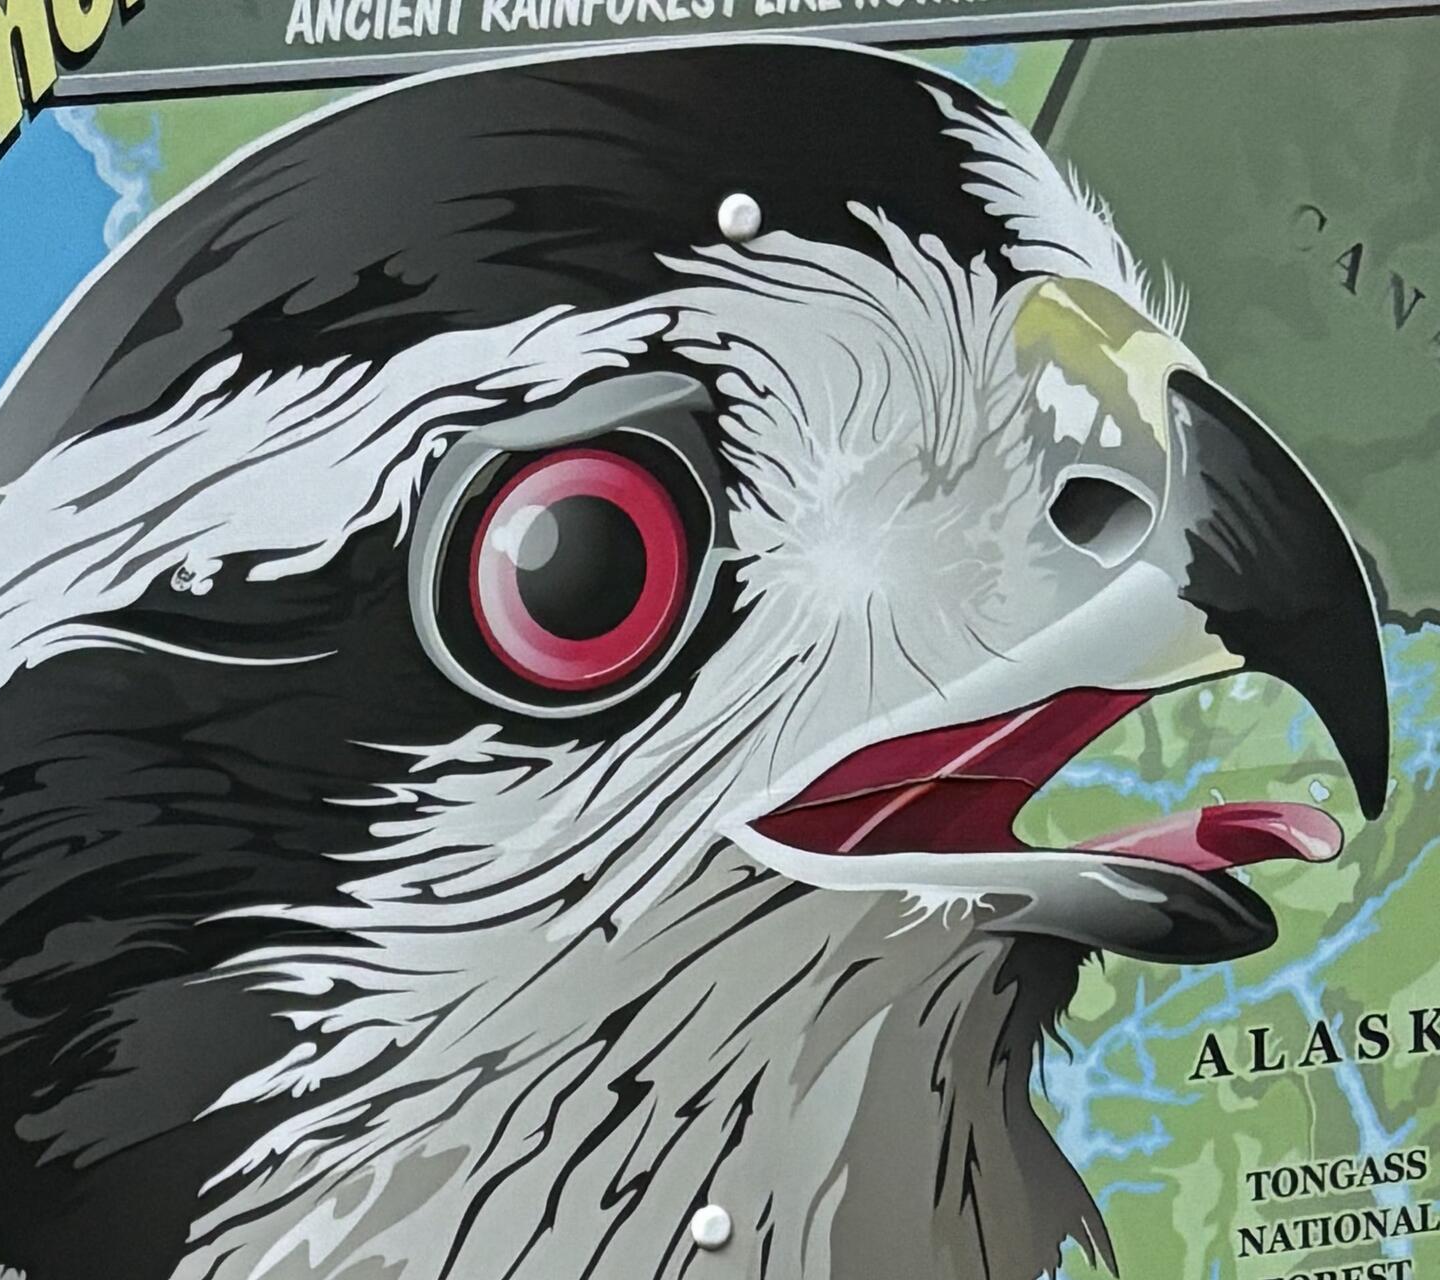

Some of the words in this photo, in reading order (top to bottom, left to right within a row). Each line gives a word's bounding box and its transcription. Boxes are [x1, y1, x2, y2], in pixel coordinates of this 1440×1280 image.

[1188, 1008, 1440, 1081] ALASK
[1245, 1149, 1428, 1203] TONGASS
[1237, 1203, 1440, 1258] NATIONAL
